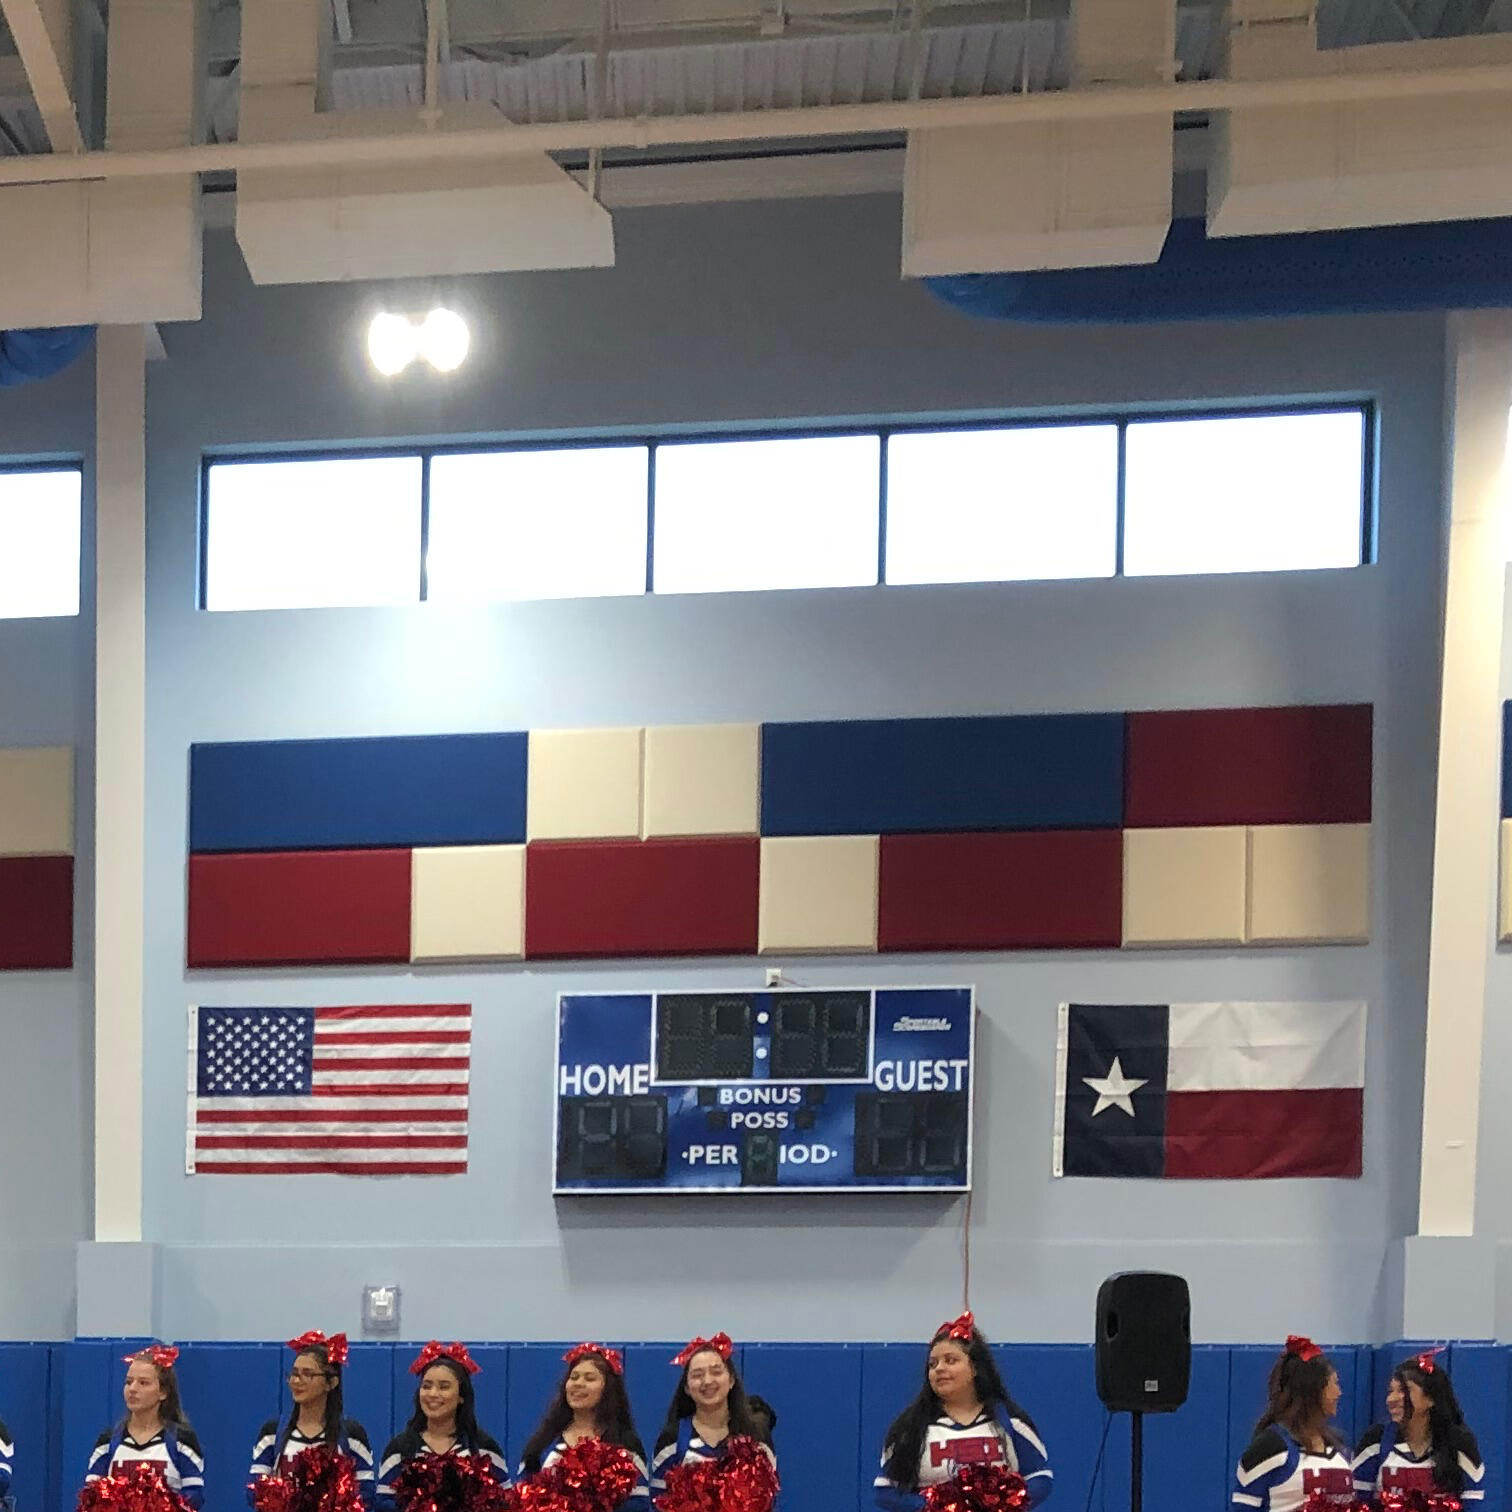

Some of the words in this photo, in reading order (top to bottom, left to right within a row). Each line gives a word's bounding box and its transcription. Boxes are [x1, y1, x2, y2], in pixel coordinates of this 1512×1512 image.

[560, 1064, 649, 1096] HOME
[875, 1060, 968, 1092] GUEST
[719, 1087, 801, 1104] BONUS
[730, 1111, 789, 1129] POSS
